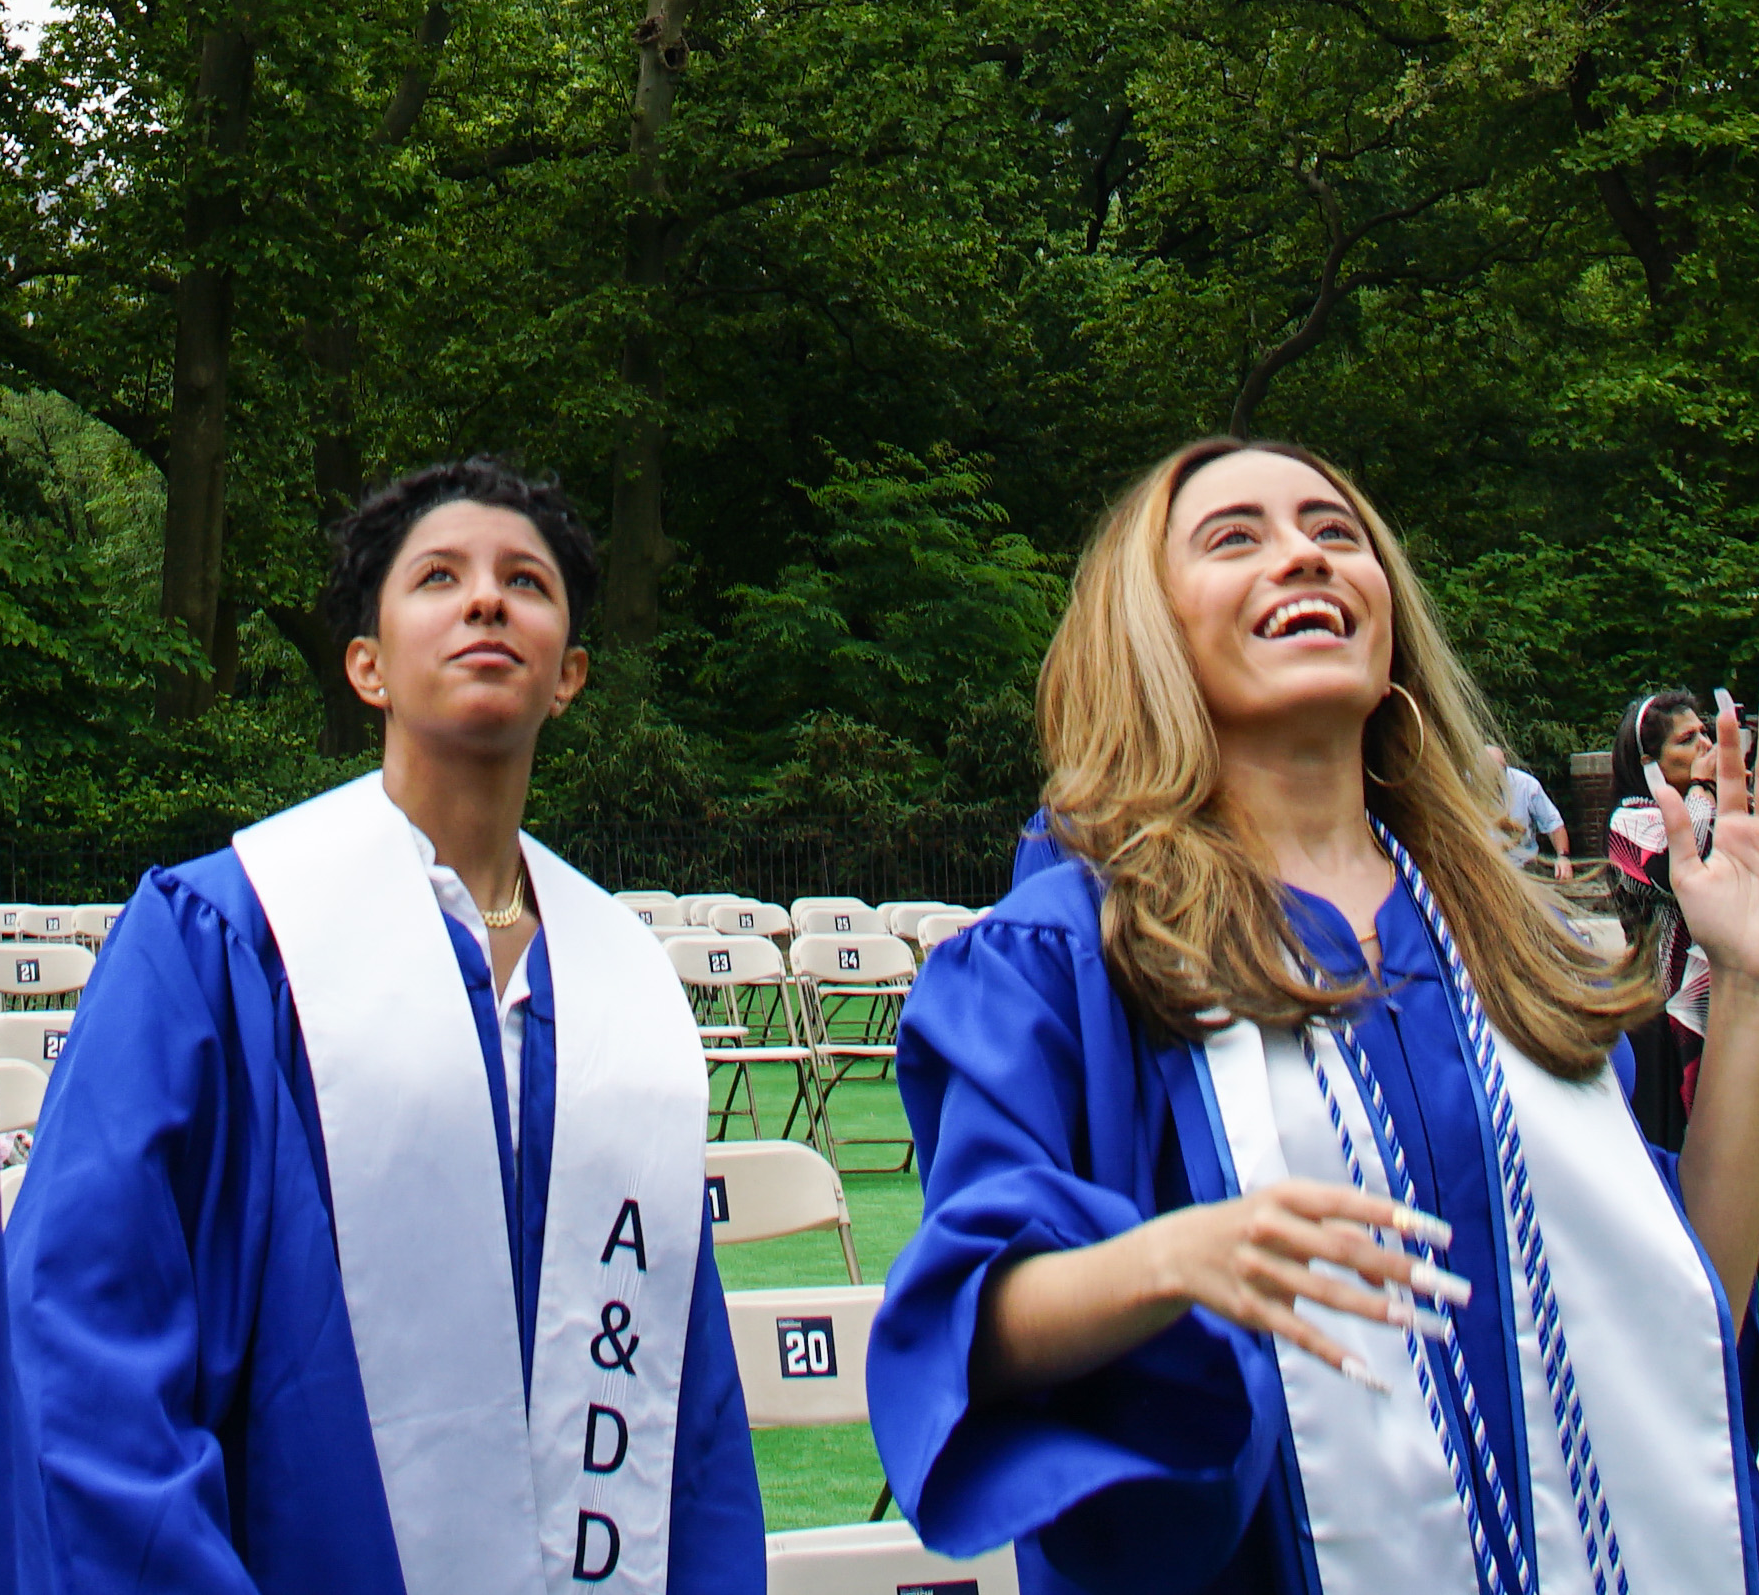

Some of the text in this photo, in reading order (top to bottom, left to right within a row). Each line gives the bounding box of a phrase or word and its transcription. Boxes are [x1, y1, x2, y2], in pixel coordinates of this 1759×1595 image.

[836, 917, 849, 931] 25
[711, 954, 729, 972] 23
[840, 951, 858, 968] 24
[20, 963, 36, 981] 21
[785, 1330, 829, 1375] 20
